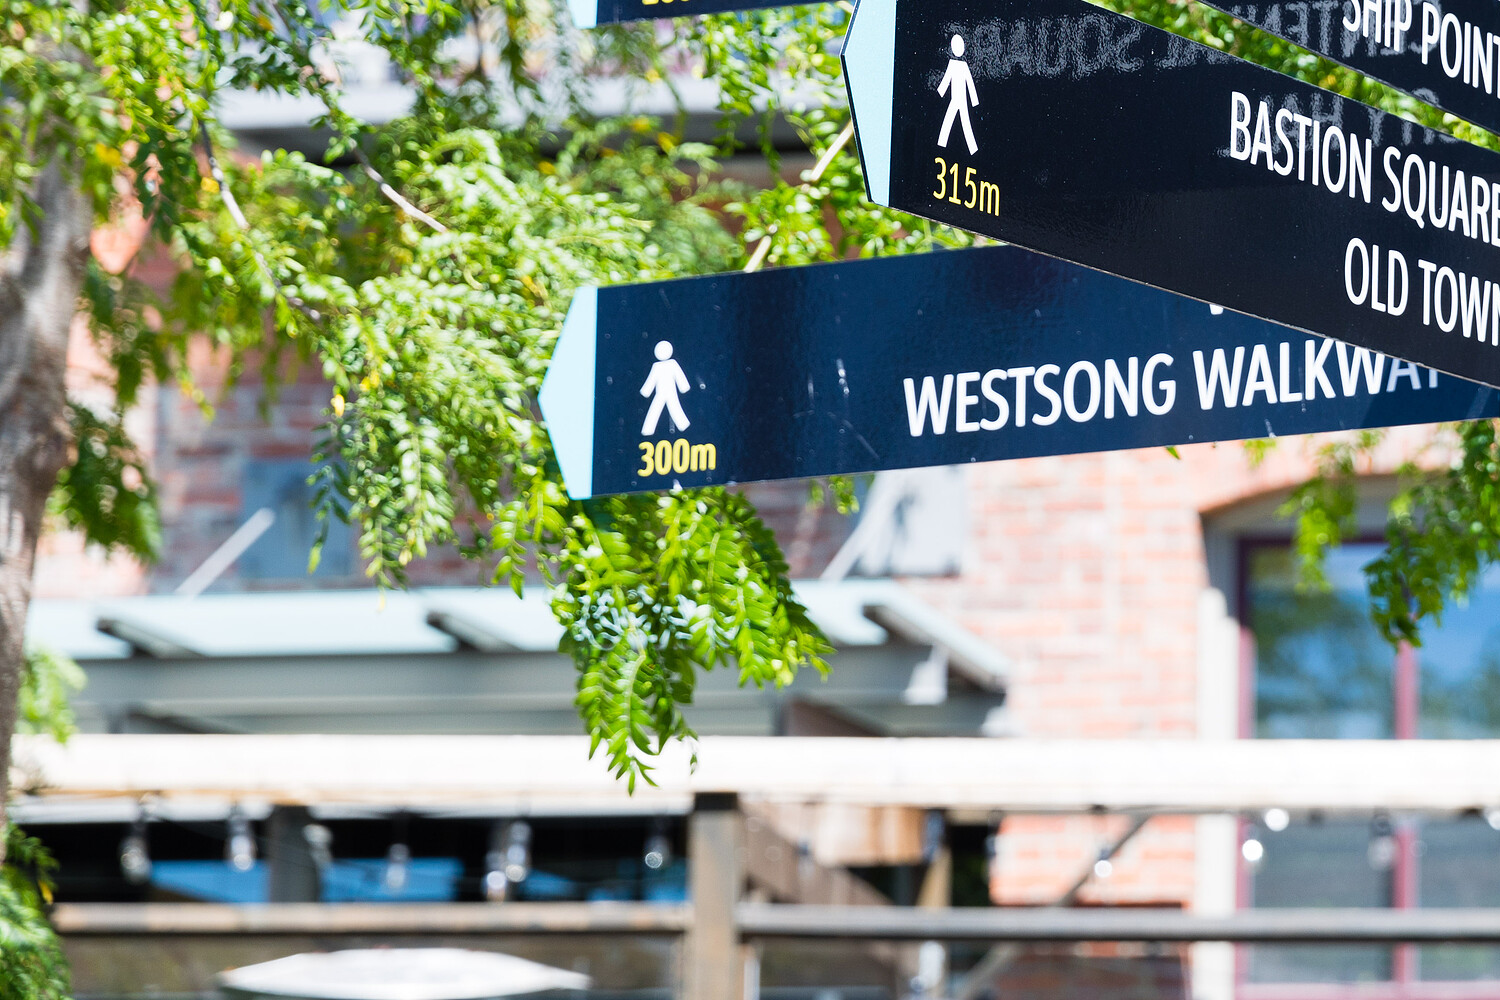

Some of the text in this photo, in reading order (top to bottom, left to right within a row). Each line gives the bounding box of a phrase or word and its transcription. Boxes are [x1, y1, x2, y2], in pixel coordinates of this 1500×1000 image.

[933, 157, 1000, 216] 315m
[1230, 92, 1373, 203] BASTION
[1344, 238, 1409, 317] OLD
[904, 353, 1177, 436] WESTSONG
[637, 439, 717, 477] 300m
